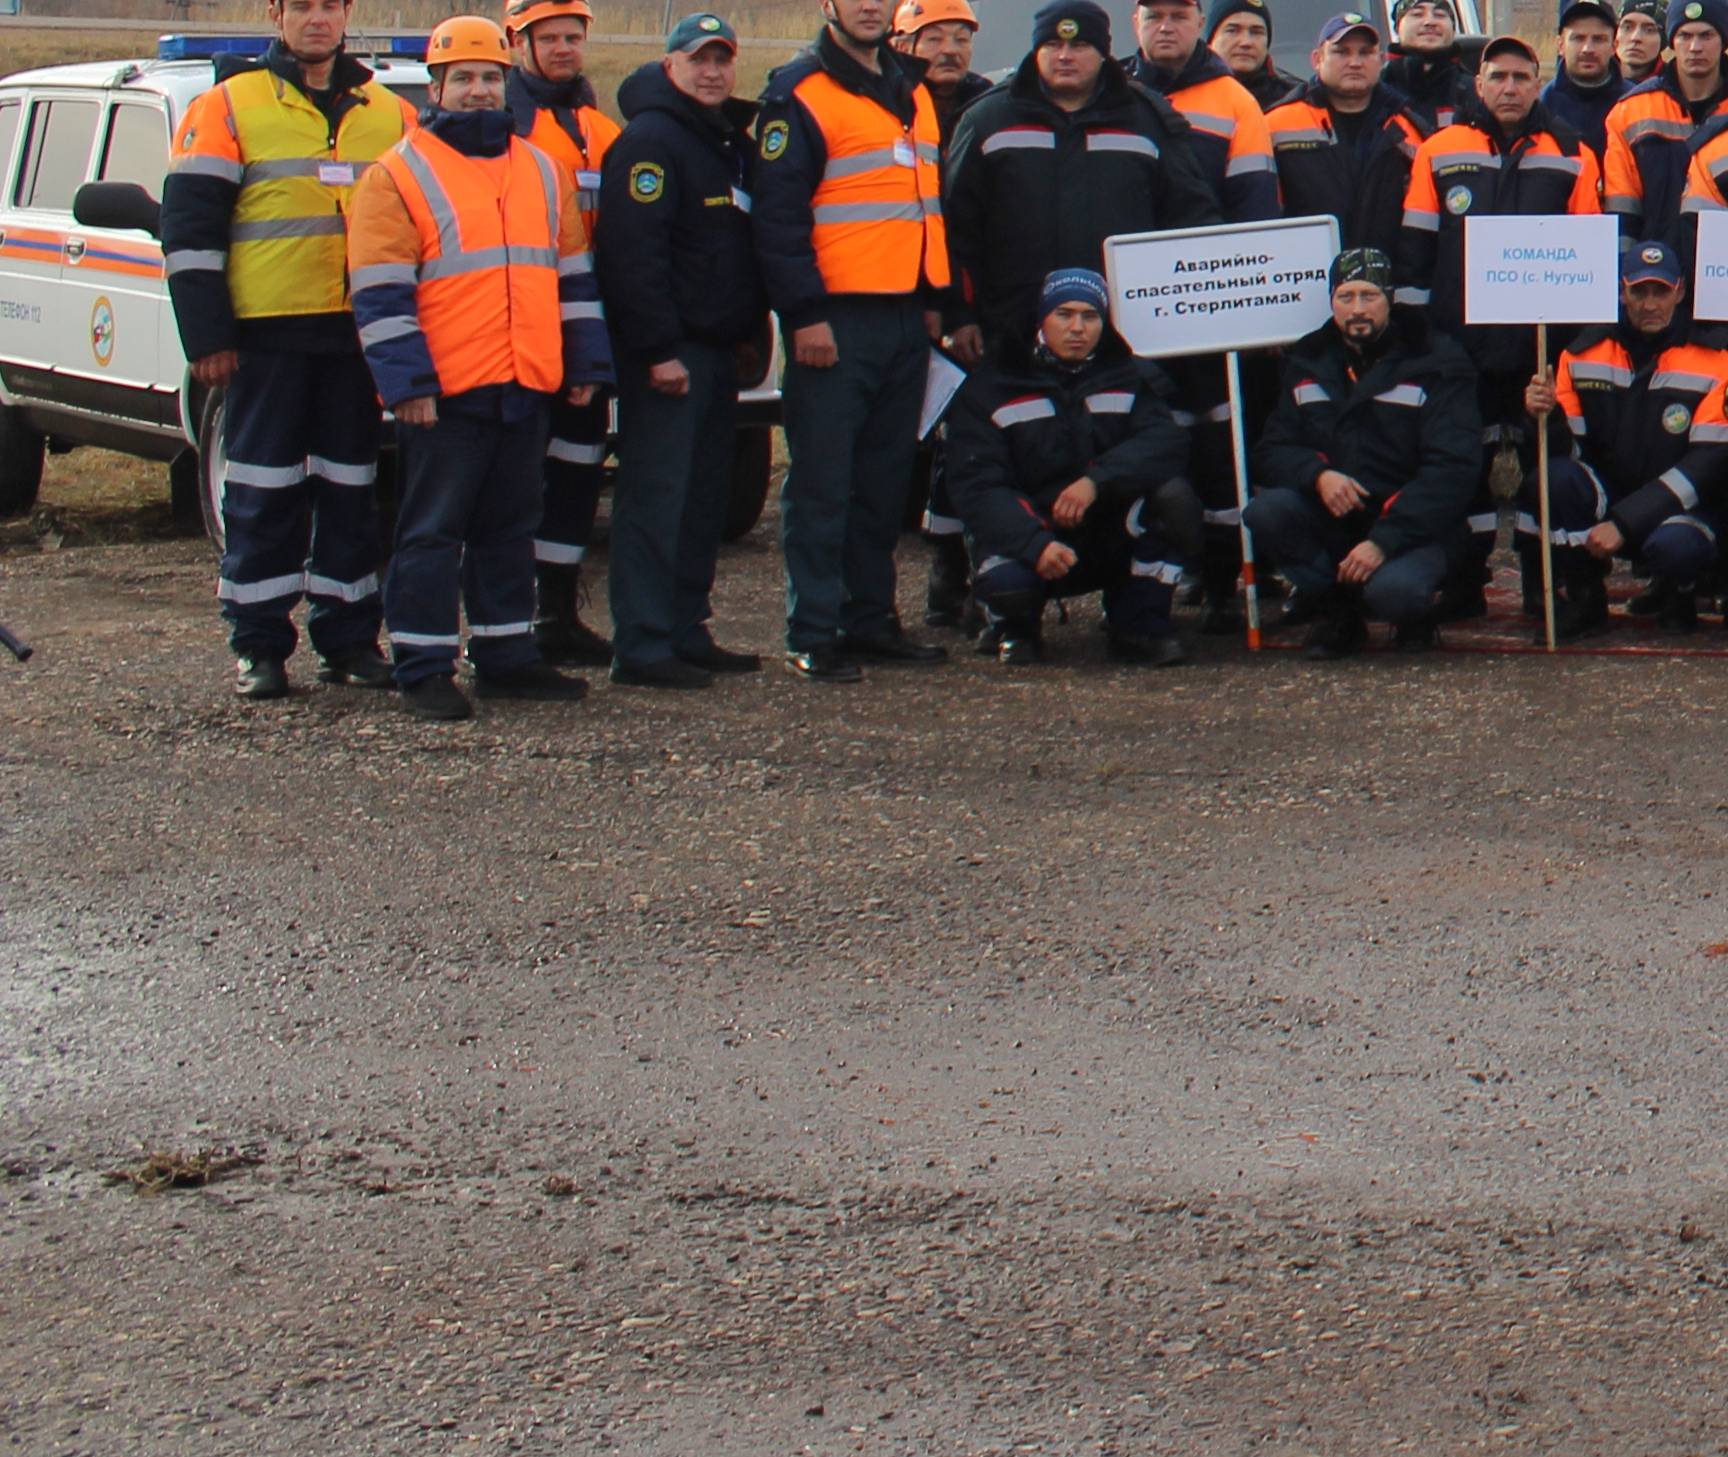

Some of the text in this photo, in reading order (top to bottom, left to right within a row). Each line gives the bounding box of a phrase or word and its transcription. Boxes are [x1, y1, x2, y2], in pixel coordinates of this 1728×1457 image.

[1174, 254, 1274, 274] Аварийно-
[1503, 247, 1577, 261] КОМАНДА
[1125, 272, 1266, 300] спасательный
[1273, 268, 1327, 285] отряд
[1486, 270, 1518, 283] ПСО
[1544, 270, 1594, 285] Нугуш)
[1154, 291, 1301, 318] г. Стерлитамак
